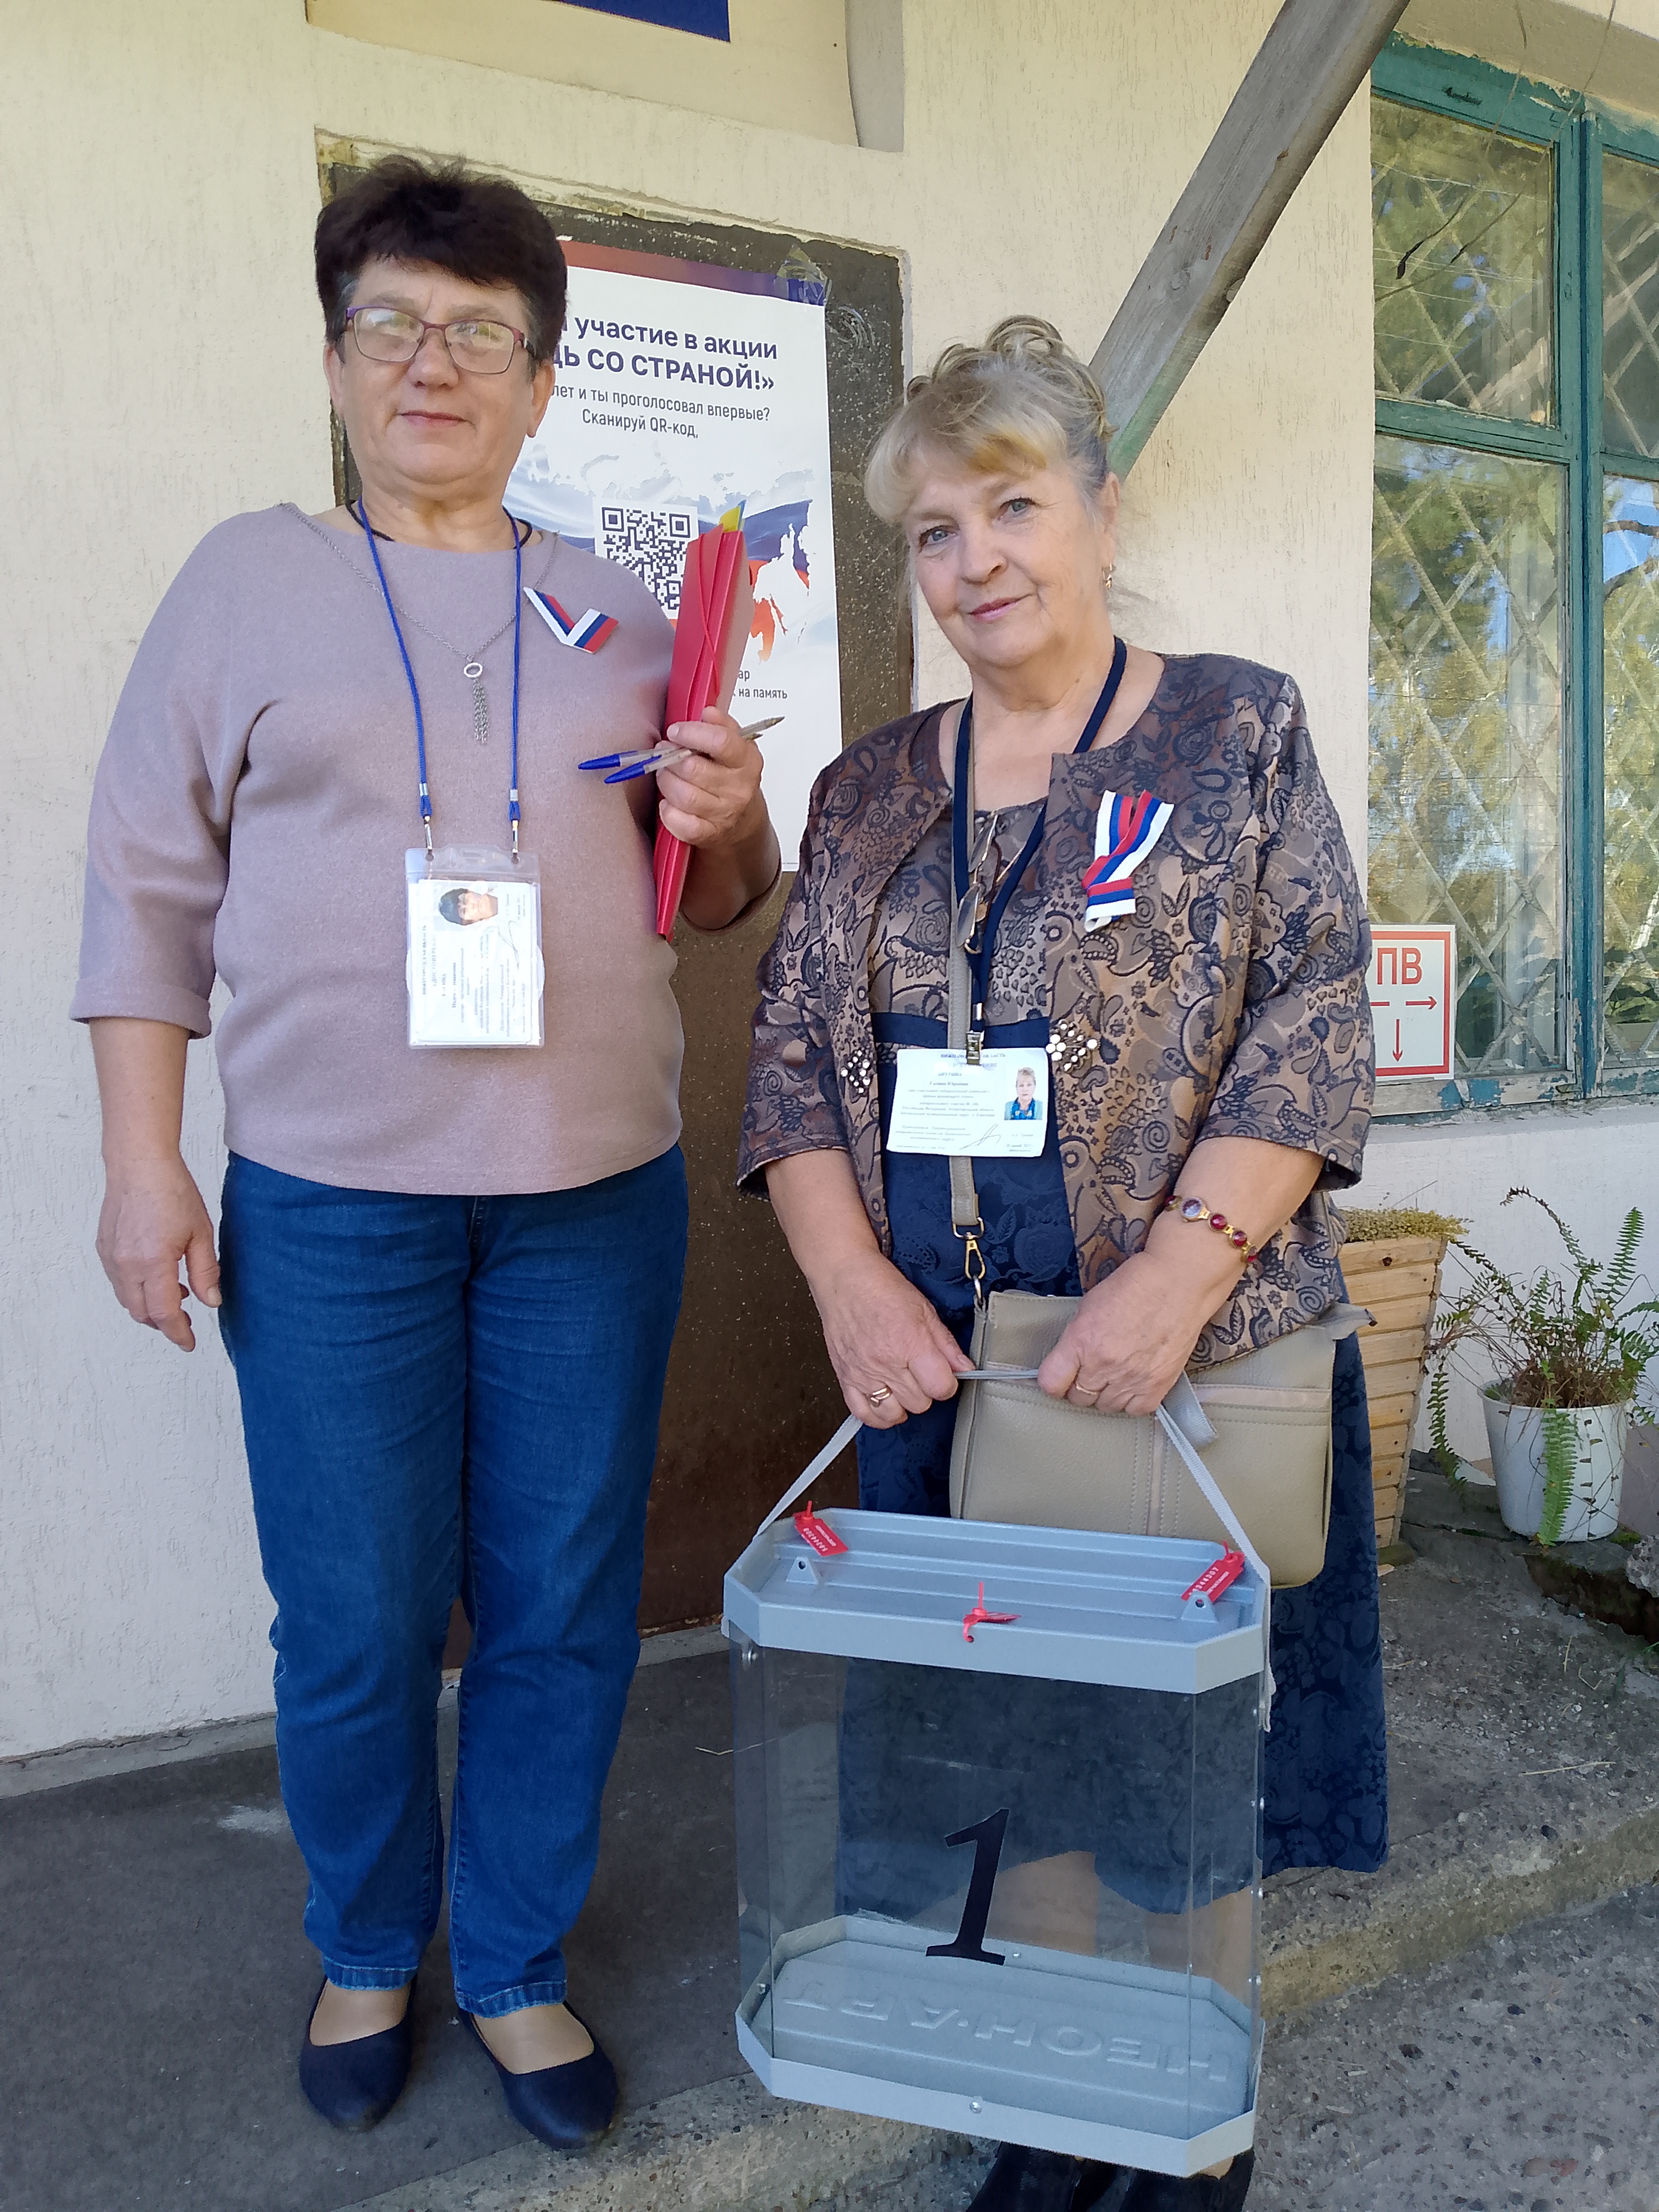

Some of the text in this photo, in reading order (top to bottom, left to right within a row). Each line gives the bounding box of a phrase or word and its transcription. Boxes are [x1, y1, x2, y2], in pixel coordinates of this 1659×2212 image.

[574, 317, 678, 347] участие
[684, 333, 698, 350] в
[704, 337, 777, 360] акции
[588, 348, 624, 373] СО
[631, 355, 774, 390] СТРАНОЙ!»
[552, 385, 770, 421] лет и ты проголосовал впервые?
[582, 408, 646, 432] Сканируй
[739, 688, 787, 699] на память
[1377, 948, 1422, 985] ПВ
[925, 1807, 1010, 1965] 1
